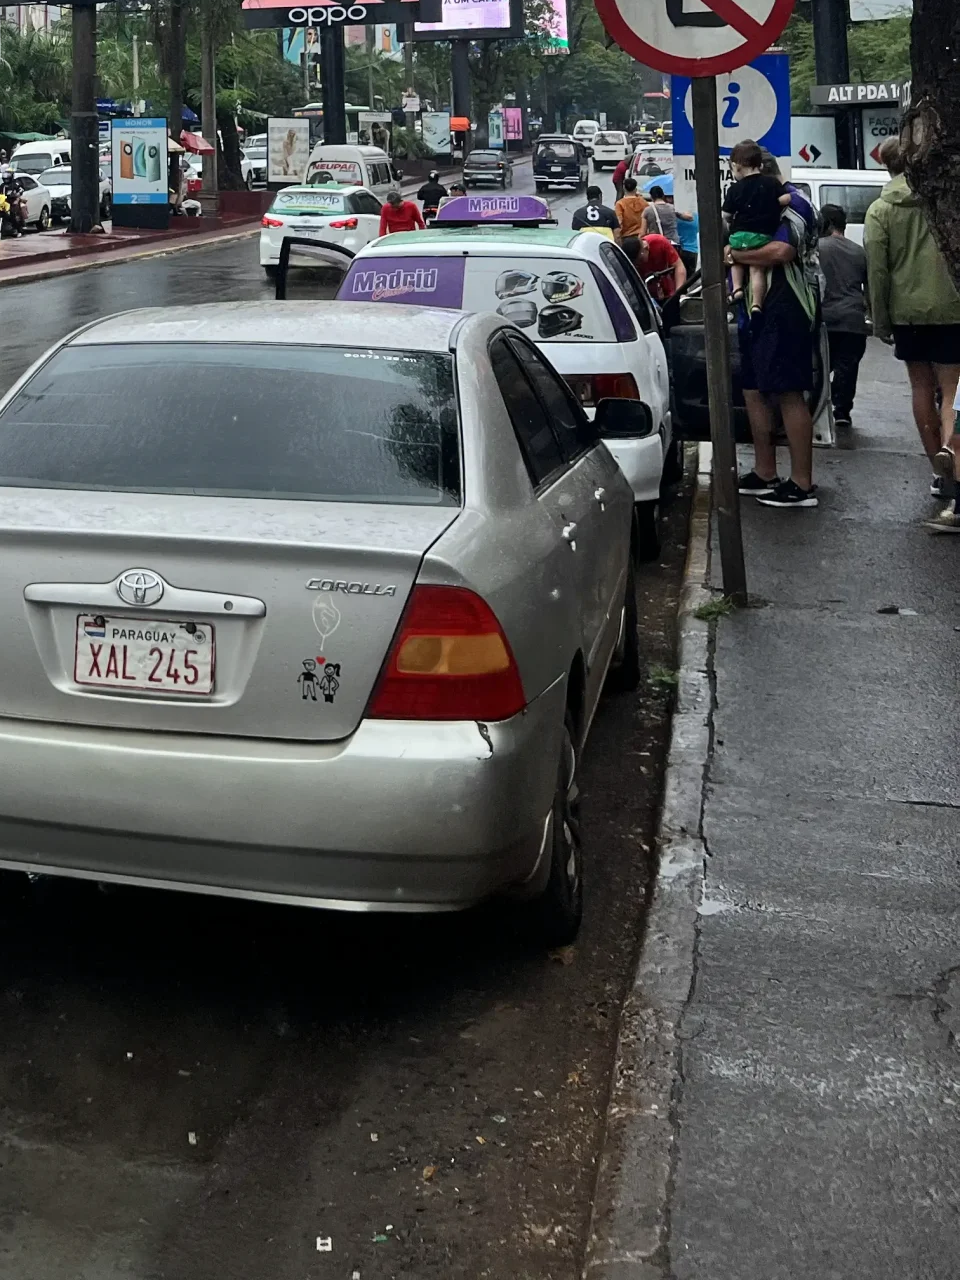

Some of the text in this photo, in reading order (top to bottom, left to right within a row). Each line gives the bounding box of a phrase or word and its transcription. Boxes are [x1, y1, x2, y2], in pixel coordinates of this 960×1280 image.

[827, 86, 855, 102] ALT
[857, 84, 889, 100] PDA
[130, 195, 138, 204] 2
[469, 197, 519, 212] Madrid
[352, 268, 438, 293] Madrid
[305, 577, 397, 597] COROLLA
[112, 628, 177, 643] PARAGUAY
[88, 643, 199, 685] XAL 245
